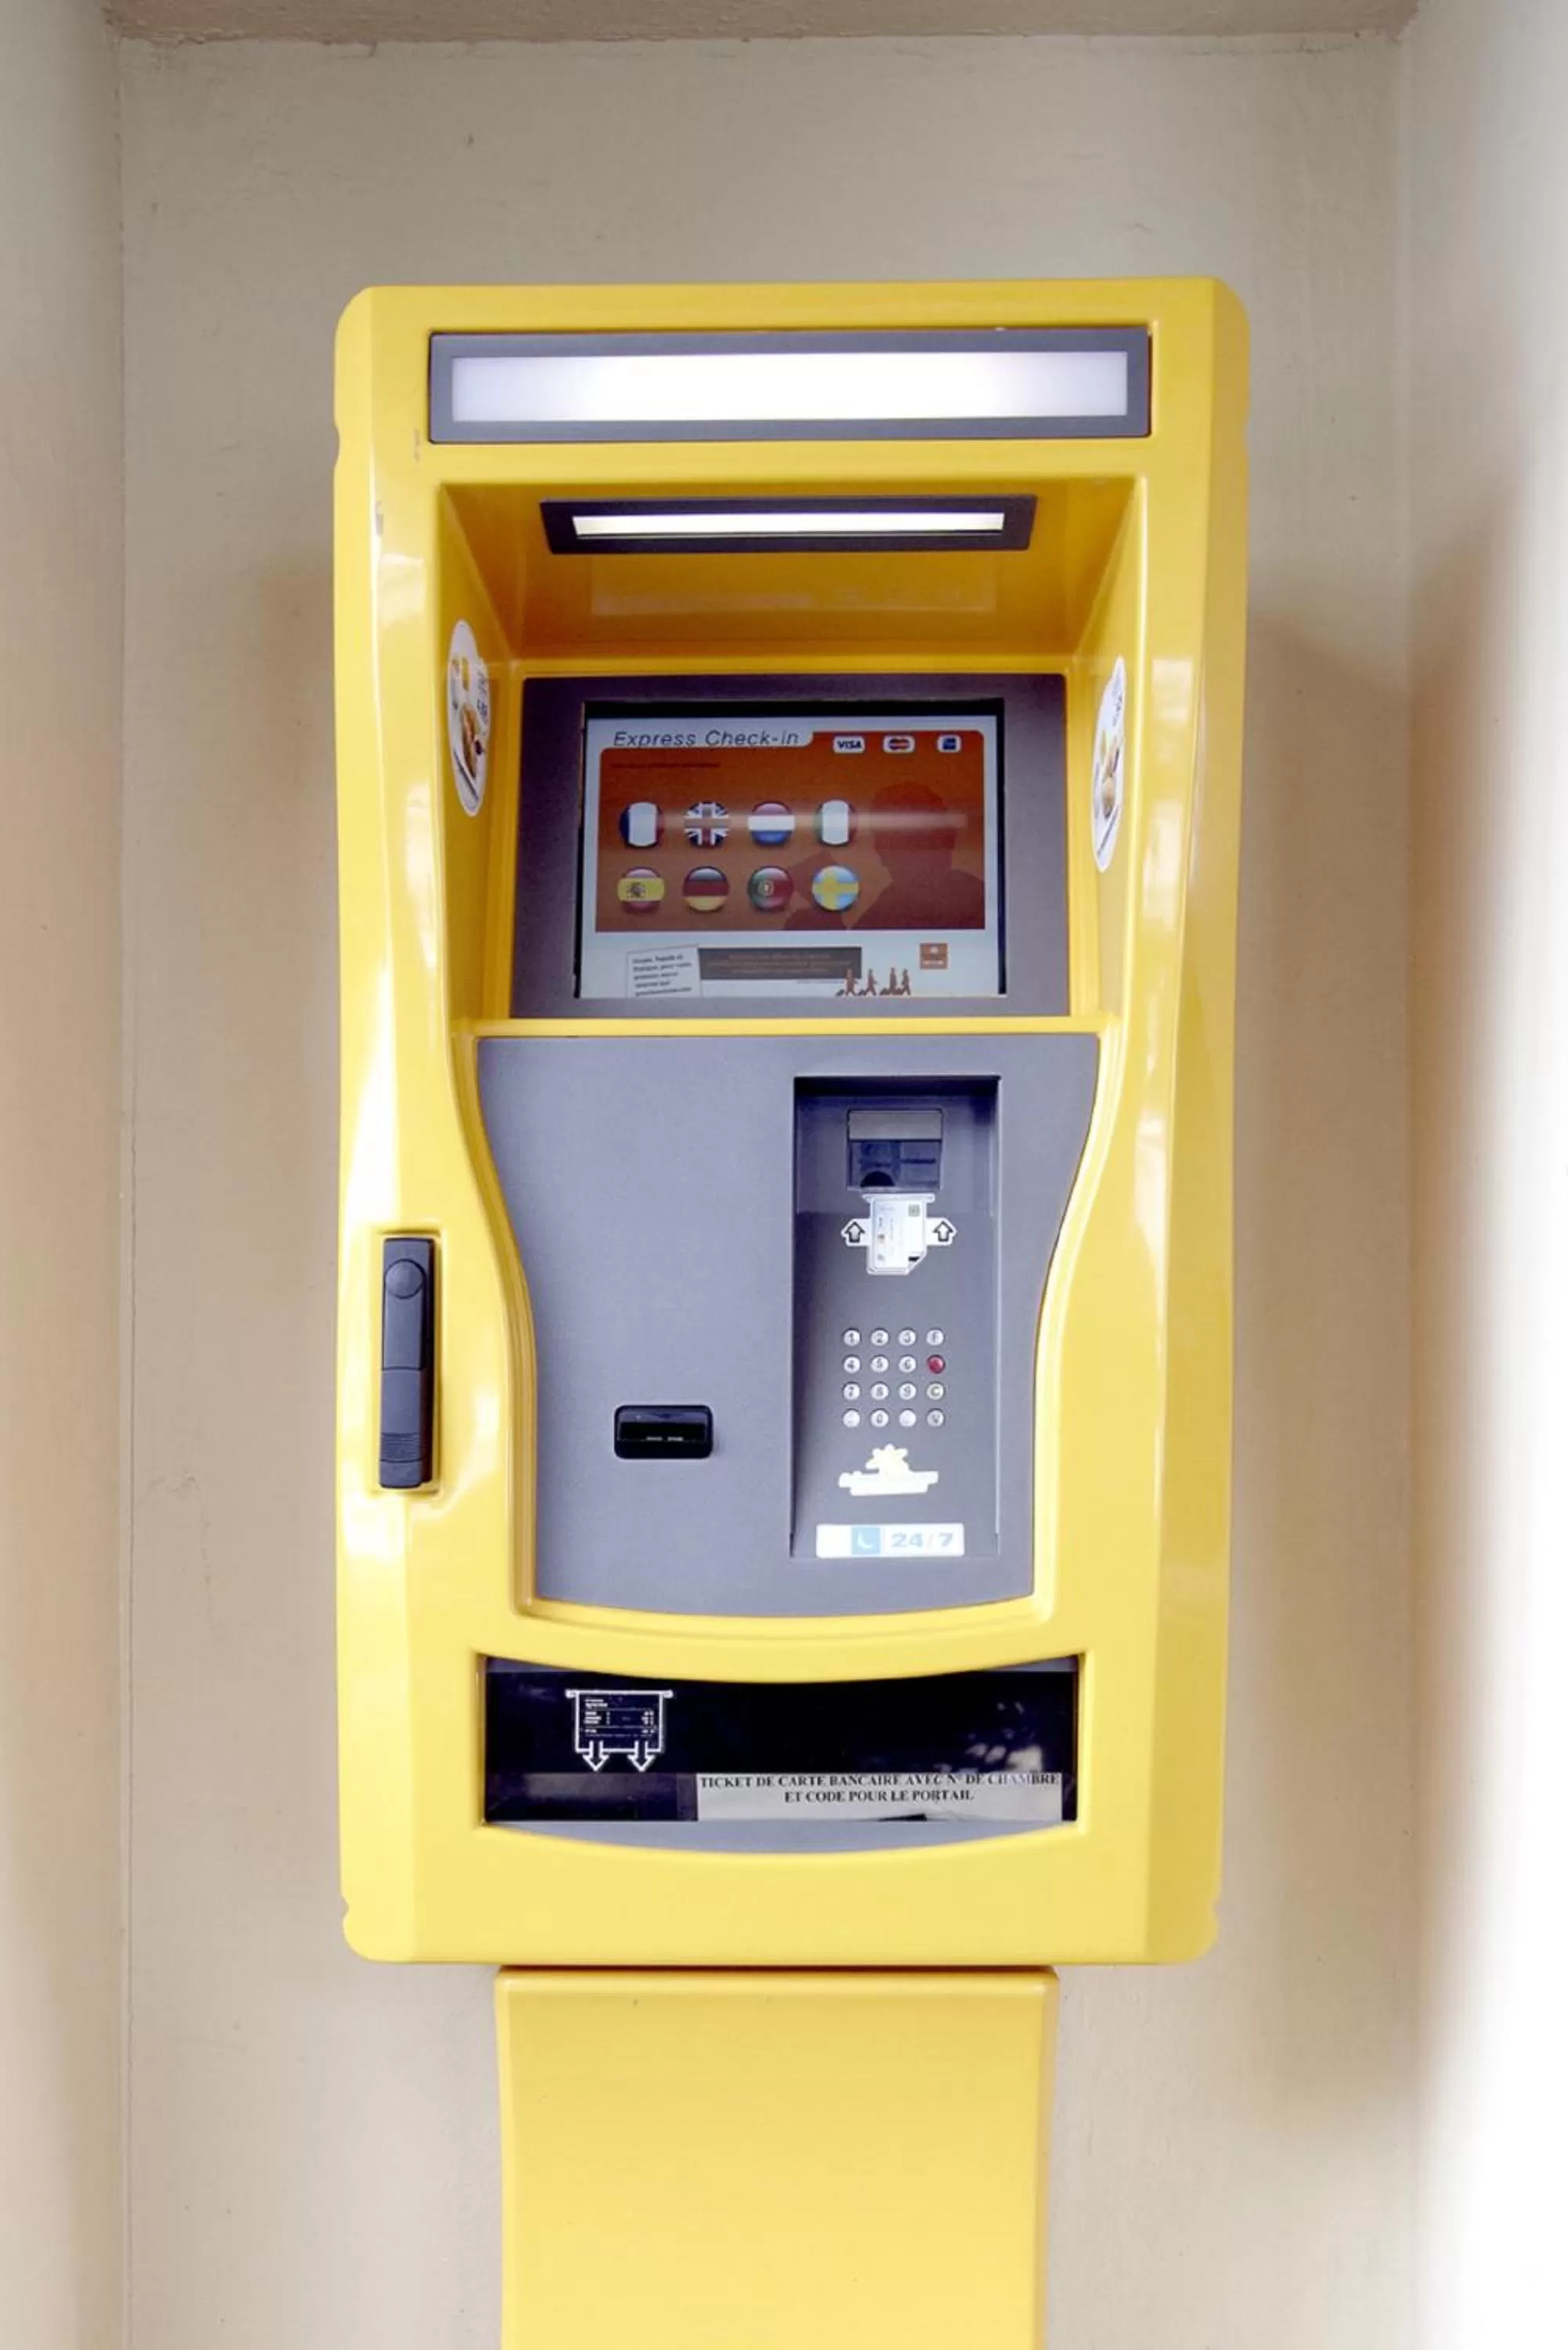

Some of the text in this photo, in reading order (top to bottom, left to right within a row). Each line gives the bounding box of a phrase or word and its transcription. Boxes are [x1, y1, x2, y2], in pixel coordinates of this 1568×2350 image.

[613, 729, 799, 748] Express Check-in
[837, 739, 862, 750] VISA
[701, 1777, 753, 1788] TICKET
[756, 1777, 775, 1788] DE
[778, 1776, 824, 1787] CARTE
[829, 1775, 901, 1787] BANCAIRE
[905, 1774, 942, 1786] AVEC
[966, 1773, 985, 1784] DE
[988, 1773, 1058, 1785] CHAMBRE
[784, 1790, 974, 1802] ET CODE POUR LE PORTAIL
